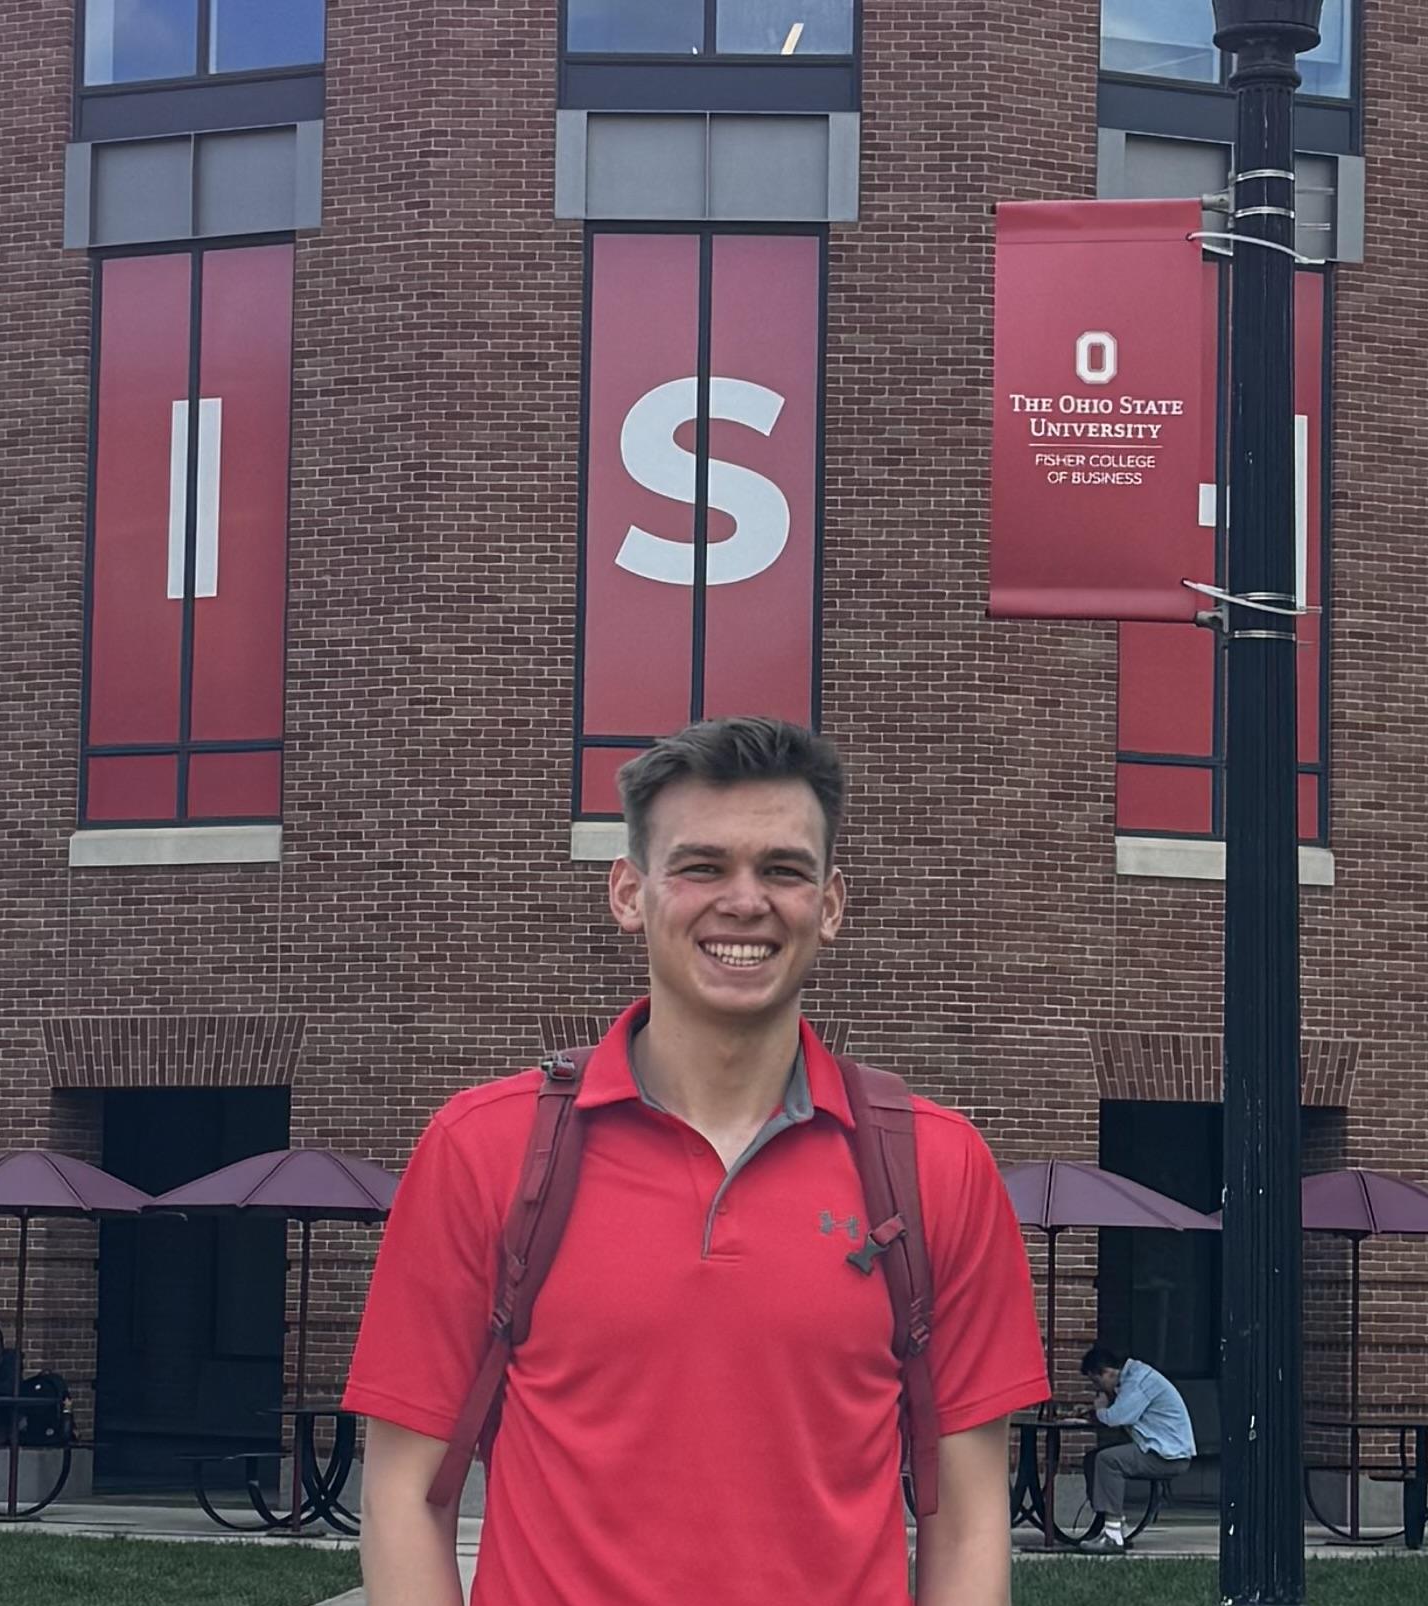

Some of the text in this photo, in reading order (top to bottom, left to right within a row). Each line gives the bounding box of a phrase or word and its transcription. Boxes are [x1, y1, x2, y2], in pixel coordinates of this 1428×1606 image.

[1010, 394, 1183, 415] THE OHIO STATE
[1029, 418, 1162, 438] UNIVERSITY
[1035, 453, 1155, 468] FISHER COLLEGE
[1047, 471, 1142, 485] OF BUSINESS
